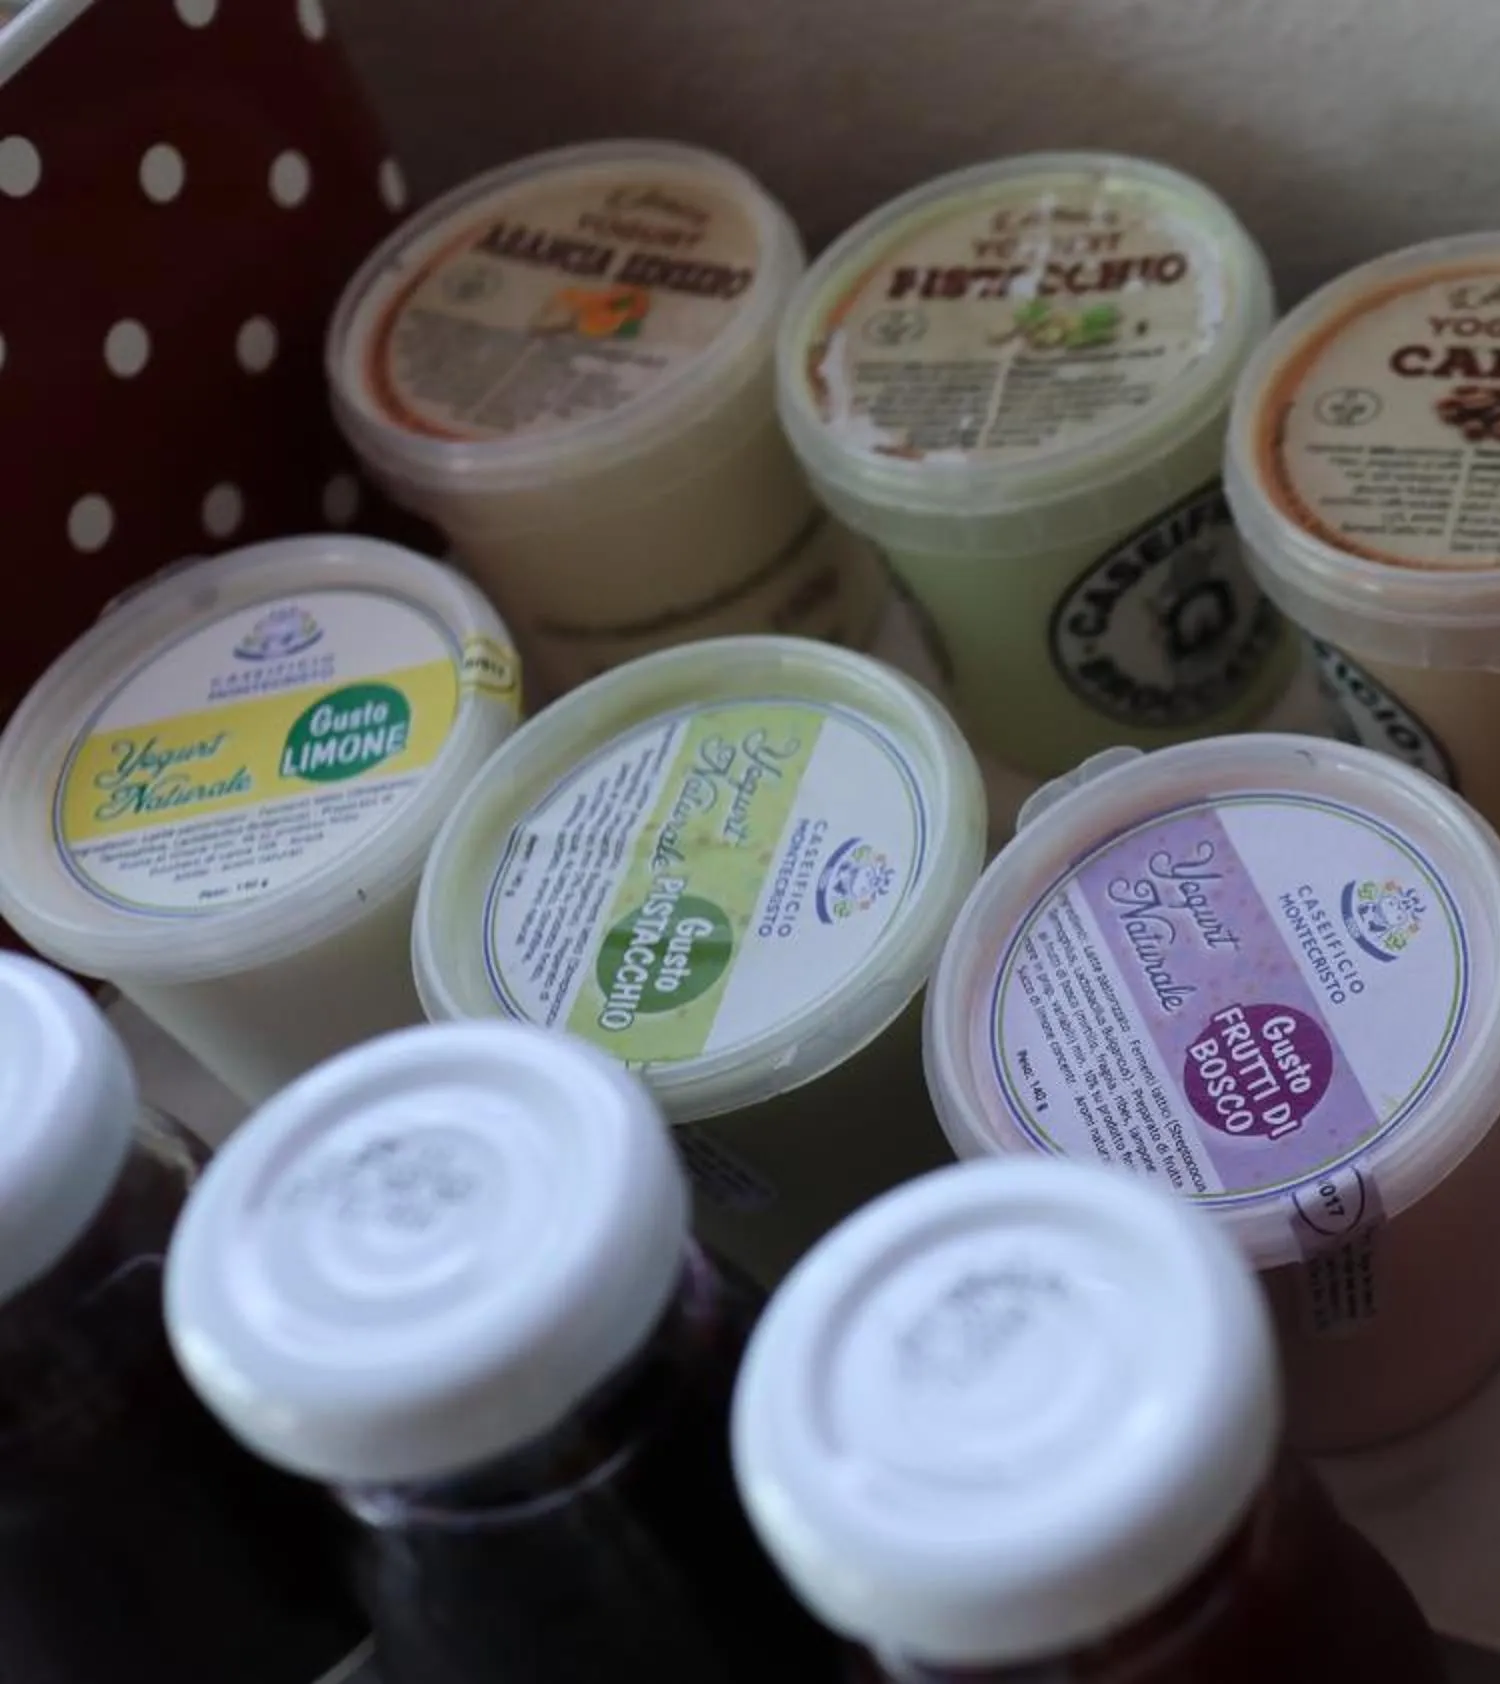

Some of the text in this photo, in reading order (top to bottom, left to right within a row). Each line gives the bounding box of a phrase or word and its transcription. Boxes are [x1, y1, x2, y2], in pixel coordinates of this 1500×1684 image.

[95, 732, 228, 790] Yogurt
[282, 722, 407, 777] LIMONE
[309, 701, 390, 737] Gusto
[651, 733, 741, 873] Naturale
[720, 728, 801, 847] Yogurt
[758, 817, 811, 940] MONTECRISTO
[777, 818, 829, 940] CASEIFICIO
[1148, 840, 1239, 952] Yogurt
[600, 875, 688, 1032] PISTACCHIO
[654, 916, 714, 992] Gusto
[1108, 876, 1197, 1013] Naturale
[1278, 891, 1347, 1006] MONTECRISTO
[1297, 884, 1365, 995] CASEIFICIO
[1127, 1038, 1159, 1087] Fermenti
[1190, 1038, 1254, 1134] BOSCO
[1213, 1006, 1300, 1138] FRUTTI DI
[1261, 1015, 1312, 1094] Gusto
[1073, 1095, 1095, 1127] Aromi
[1096, 1102, 1128, 1152] prodotto
[1128, 1087, 1163, 1143] Preparato
[1155, 1141, 1169, 1155] di
